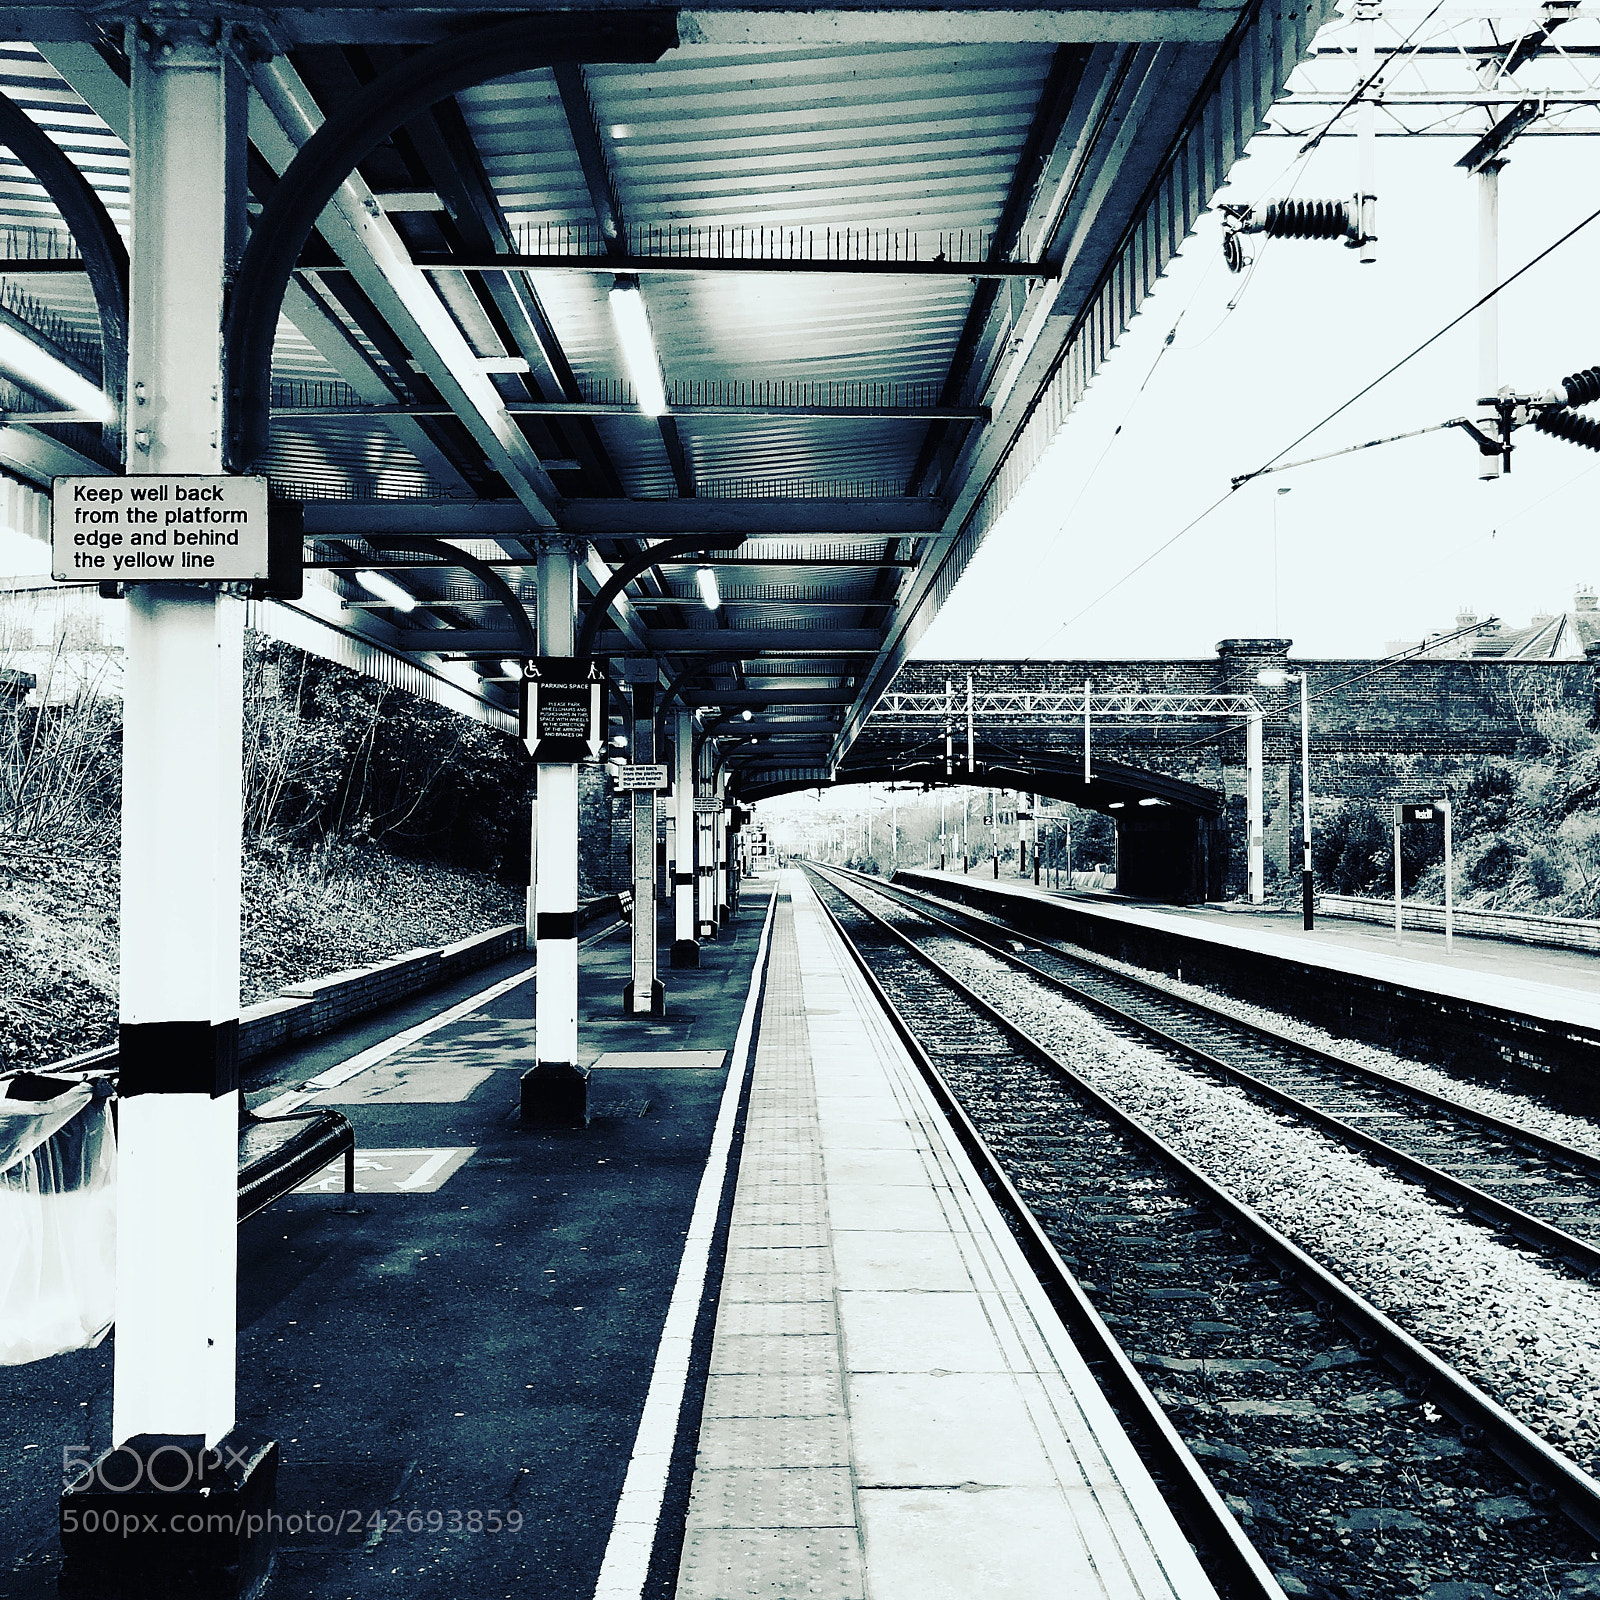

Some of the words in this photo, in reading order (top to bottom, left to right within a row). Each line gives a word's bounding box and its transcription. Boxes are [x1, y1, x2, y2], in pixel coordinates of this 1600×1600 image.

[74, 485, 123, 503] Keep
[131, 485, 168, 501] well
[175, 485, 224, 501] back
[74, 507, 119, 523] from
[127, 507, 158, 523] the
[165, 507, 248, 526] platform
[74, 529, 123, 548] edge
[130, 529, 167, 545] and
[173, 529, 239, 545] behind
[74, 552, 105, 568] the
[113, 552, 174, 571] yellow
[181, 552, 215, 568] line
[985, 816, 992, 825] 2
